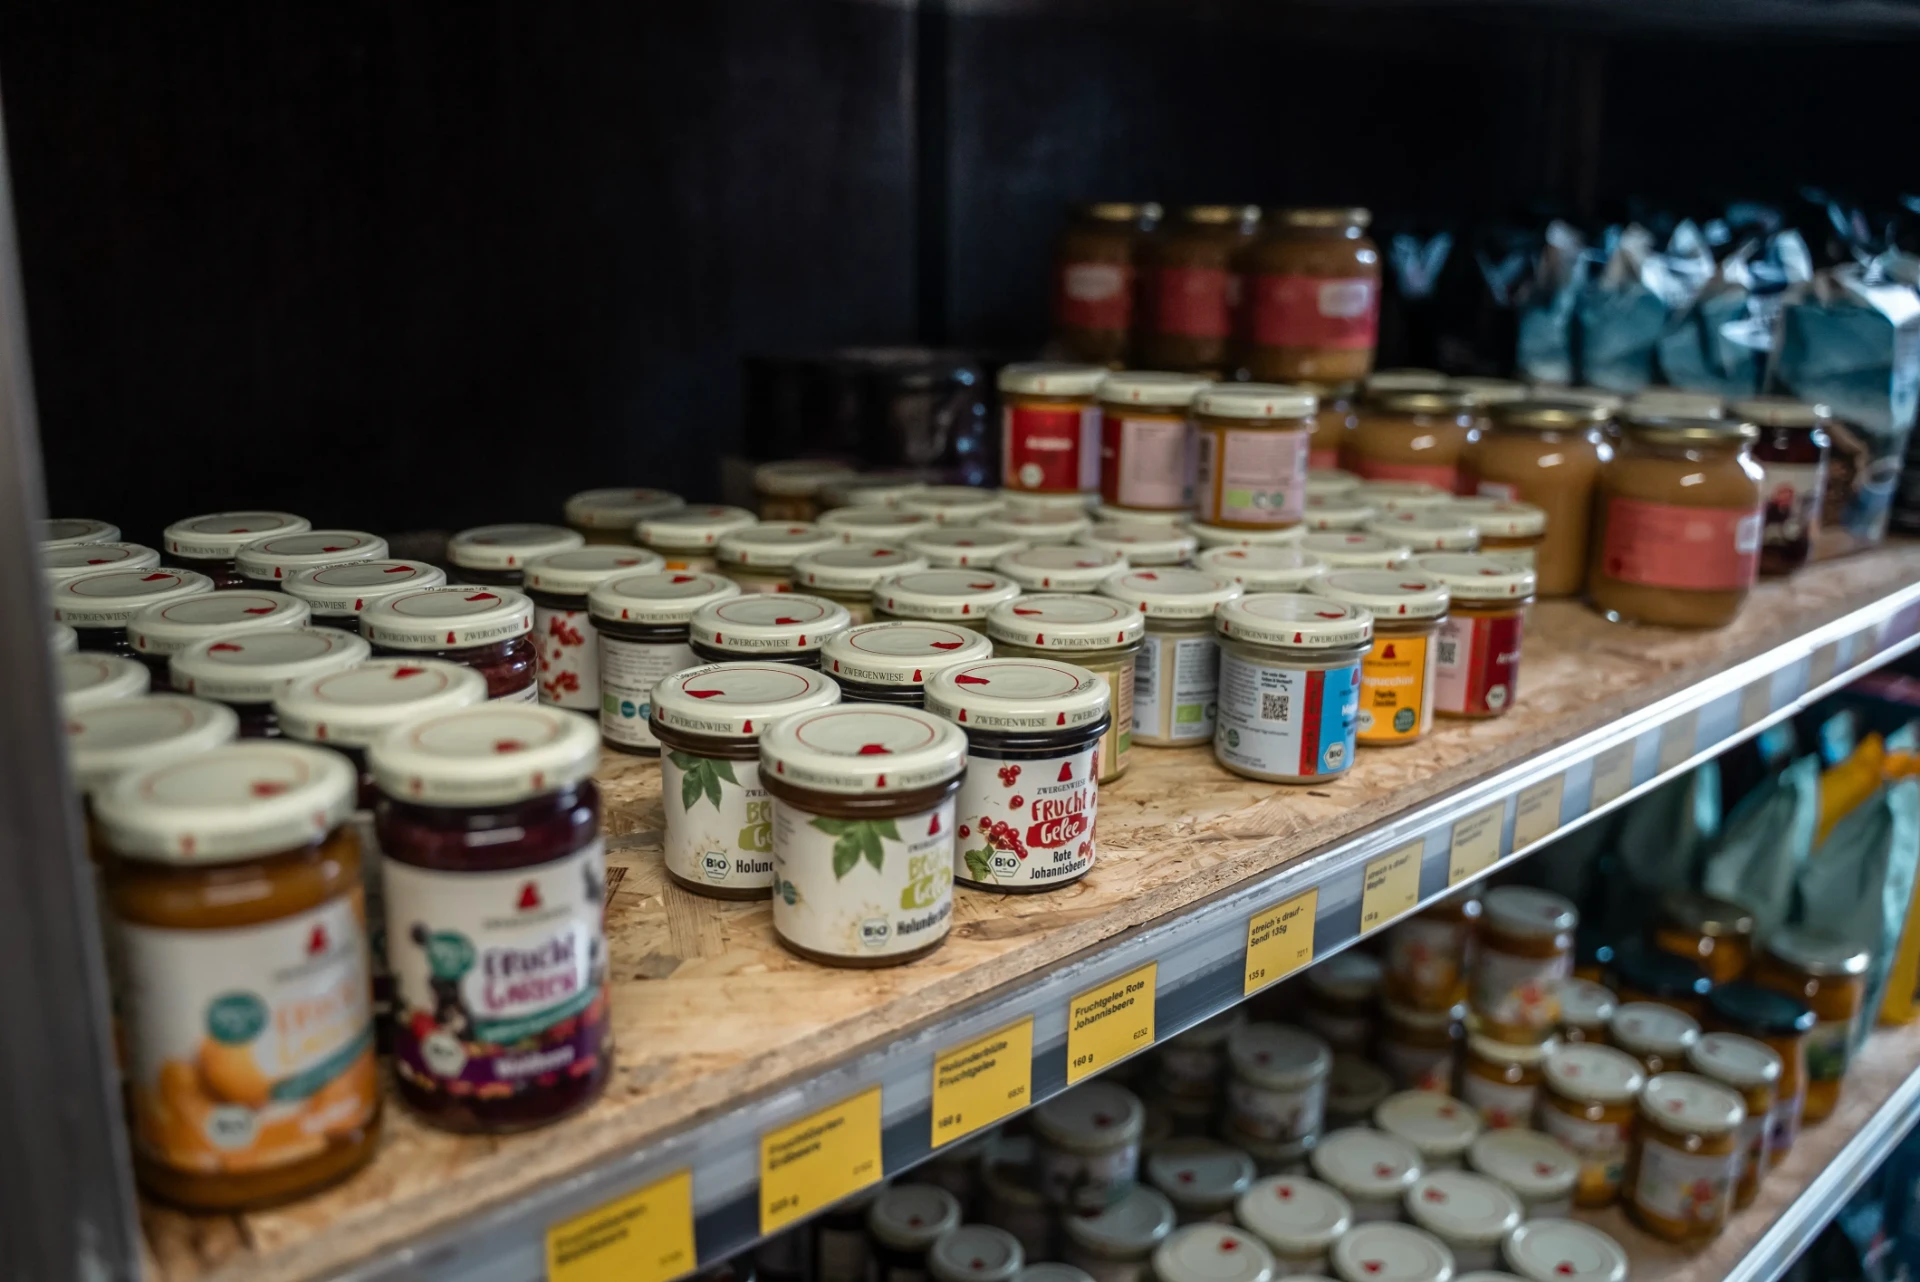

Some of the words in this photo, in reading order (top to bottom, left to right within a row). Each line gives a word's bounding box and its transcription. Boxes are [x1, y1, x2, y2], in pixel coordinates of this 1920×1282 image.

[728, 637, 790, 648] ZWERGENWIESE
[1051, 637, 1111, 646] ZWERGENWIESE
[844, 665, 905, 681] ZWERGENWIESE
[670, 714, 733, 732] ZWERGENWIESE
[974, 715, 1047, 727] ZWERGENWIESE
[1037, 779, 1086, 795] ZWERGENWIESE
[1040, 818, 1080, 844] Gelee
[1053, 849, 1072, 863] Rote
[1030, 858, 1086, 879] Johannisbeere
[1282, 906, 1300, 922] drauf
[1250, 932, 1270, 947] Sendi
[1271, 924, 1288, 937] 135g
[1248, 969, 1260, 981] 135
[1074, 991, 1124, 1018] Fruchtgelee
[1126, 980, 1145, 995] Rote
[1074, 997, 1135, 1031] Johannisbeere
[1133, 1027, 1148, 1040] 6232
[1073, 1055, 1087, 1068] 160
[1088, 1054, 1094, 1063] g
